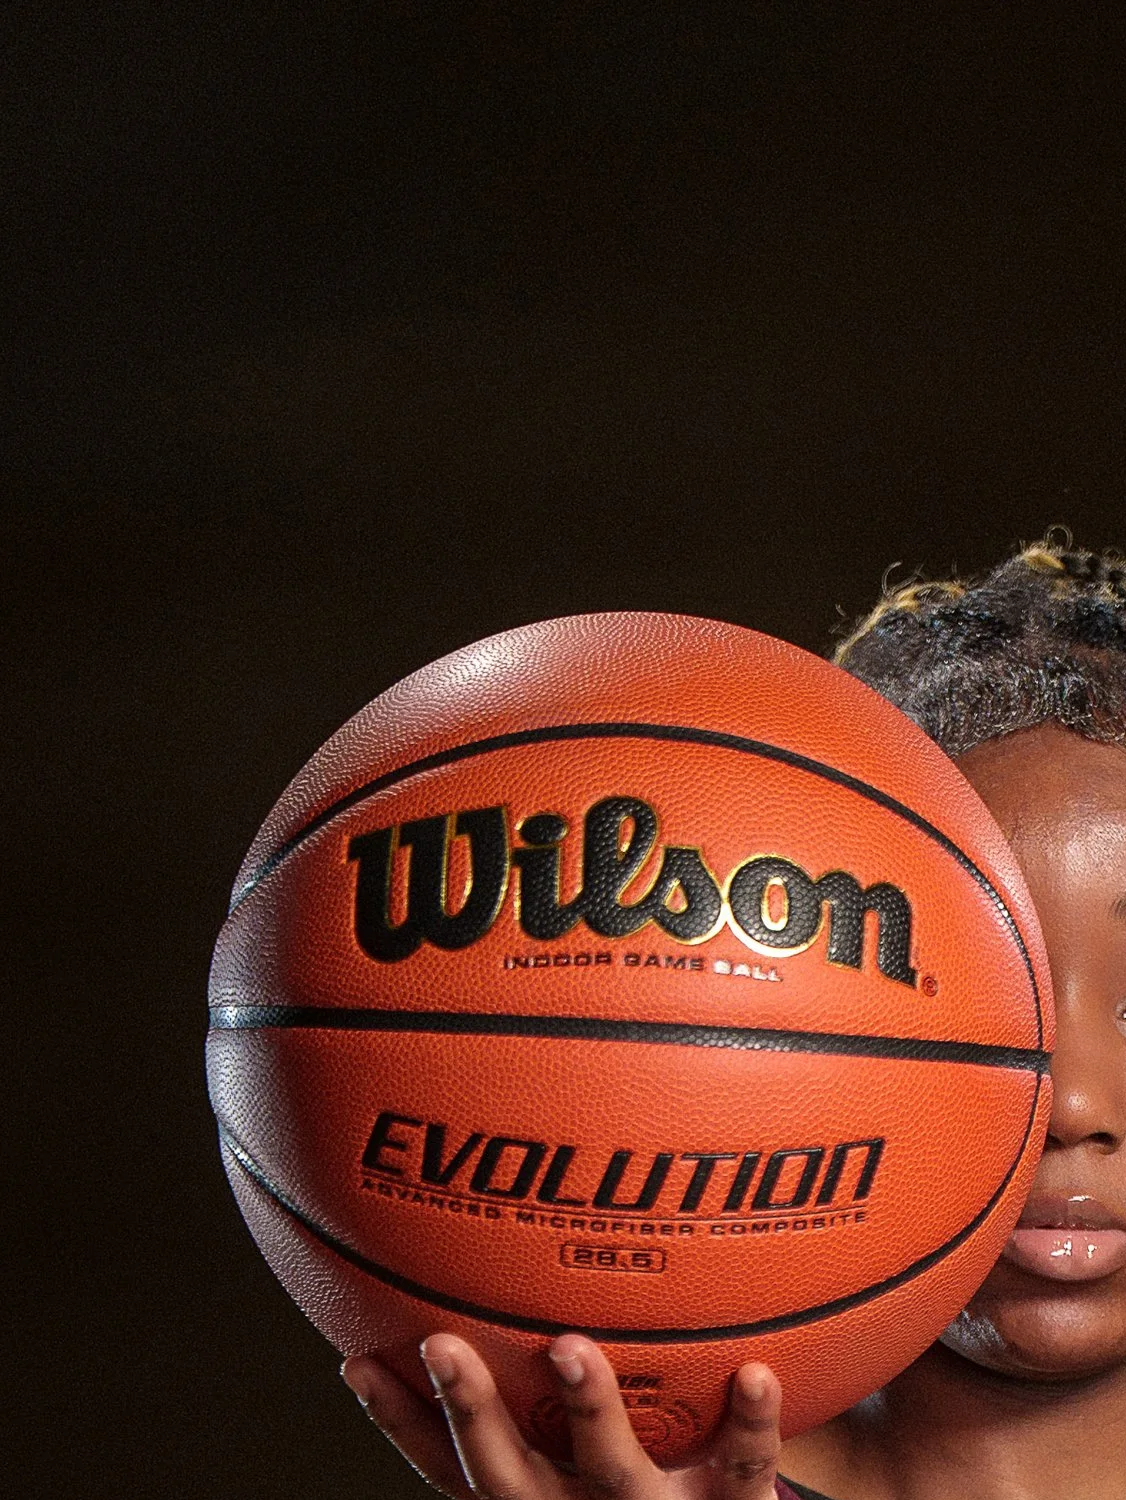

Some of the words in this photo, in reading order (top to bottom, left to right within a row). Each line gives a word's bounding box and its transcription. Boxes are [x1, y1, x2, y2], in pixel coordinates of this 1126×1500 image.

[347, 795, 924, 990] Wilson
[503, 952, 612, 970] INDOOR
[624, 952, 706, 972] GAME
[713, 959, 784, 983] BALL
[361, 1111, 887, 1211] EVOLUTION
[361, 1178, 502, 1220] ADVANCED
[515, 1211, 696, 1236] MICROFIBER
[709, 1211, 867, 1236] COMPOSITE
[572, 1248, 654, 1270] 28.5
